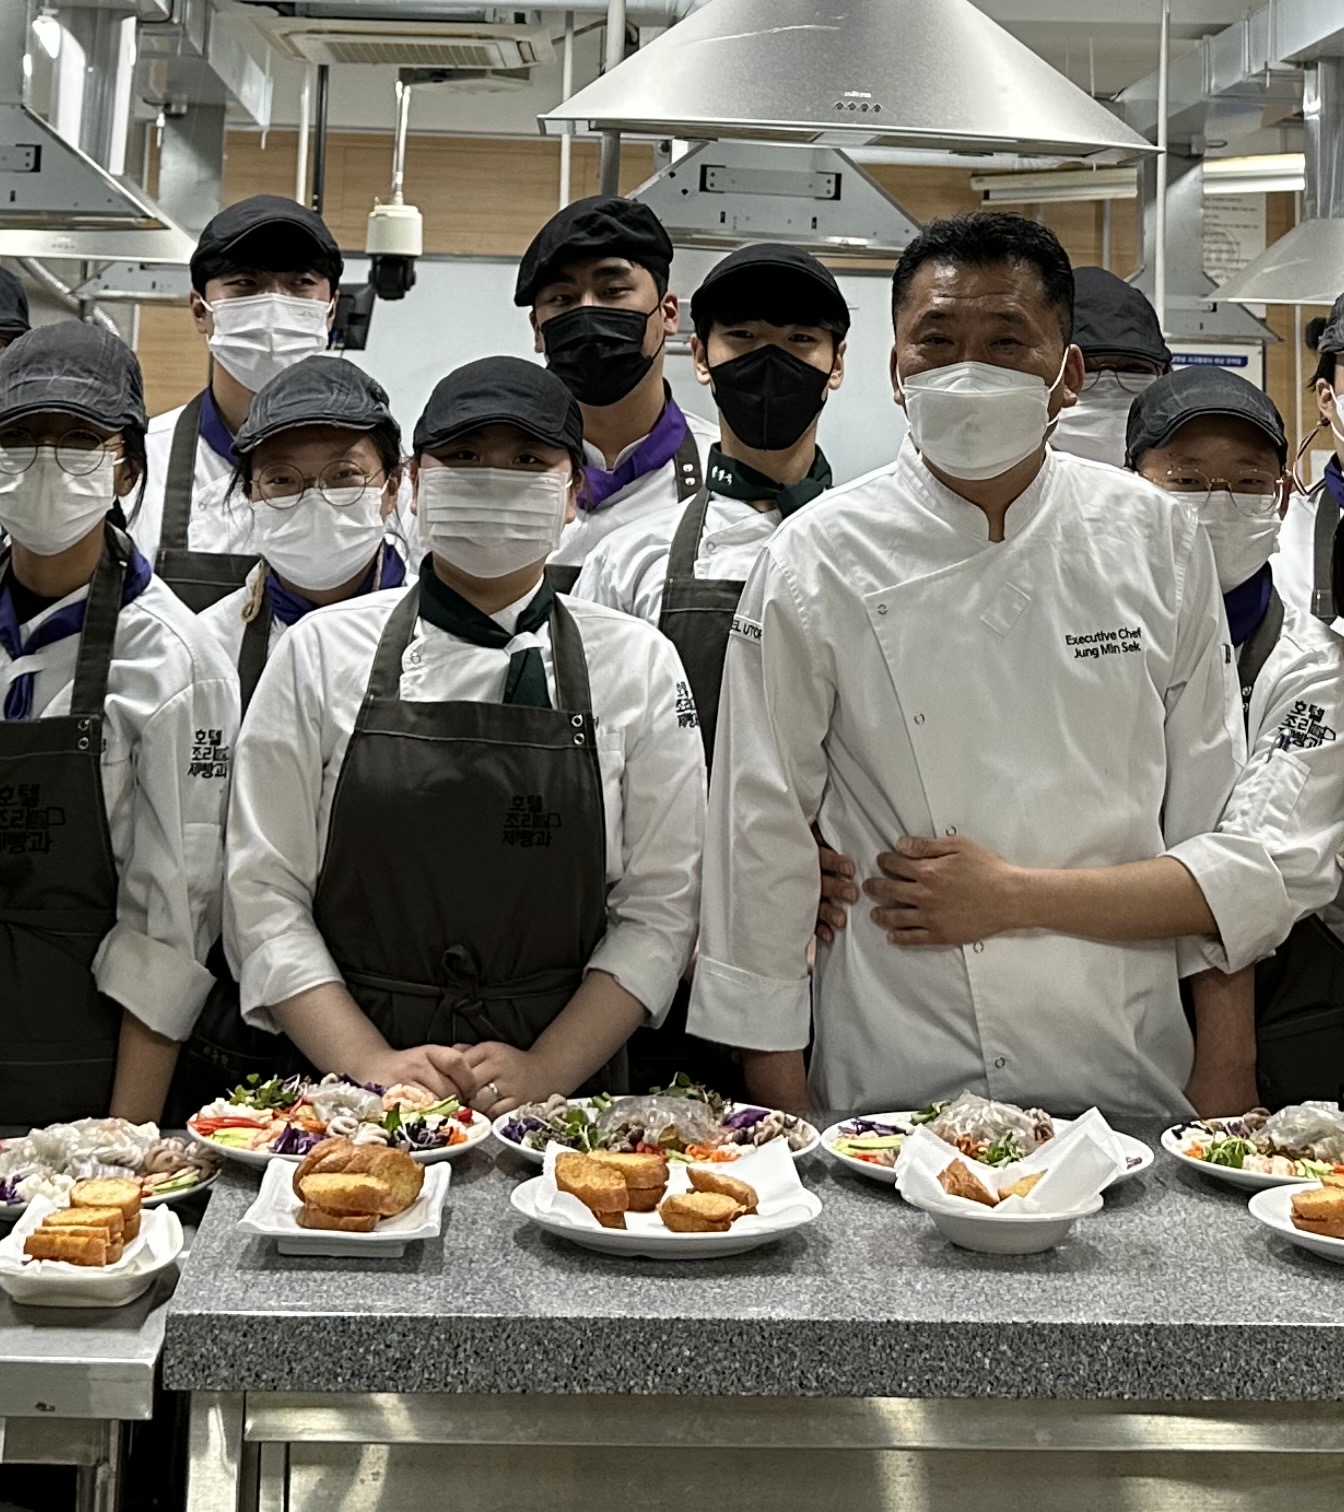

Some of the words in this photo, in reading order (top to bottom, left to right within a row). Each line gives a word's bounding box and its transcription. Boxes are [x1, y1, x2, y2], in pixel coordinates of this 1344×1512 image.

[1065, 630, 1117, 646] Executive
[1117, 626, 1143, 640] Chef
[1073, 643, 1100, 659] Jung
[1100, 643, 1122, 655] Min
[1121, 641, 1142, 654] Sek
